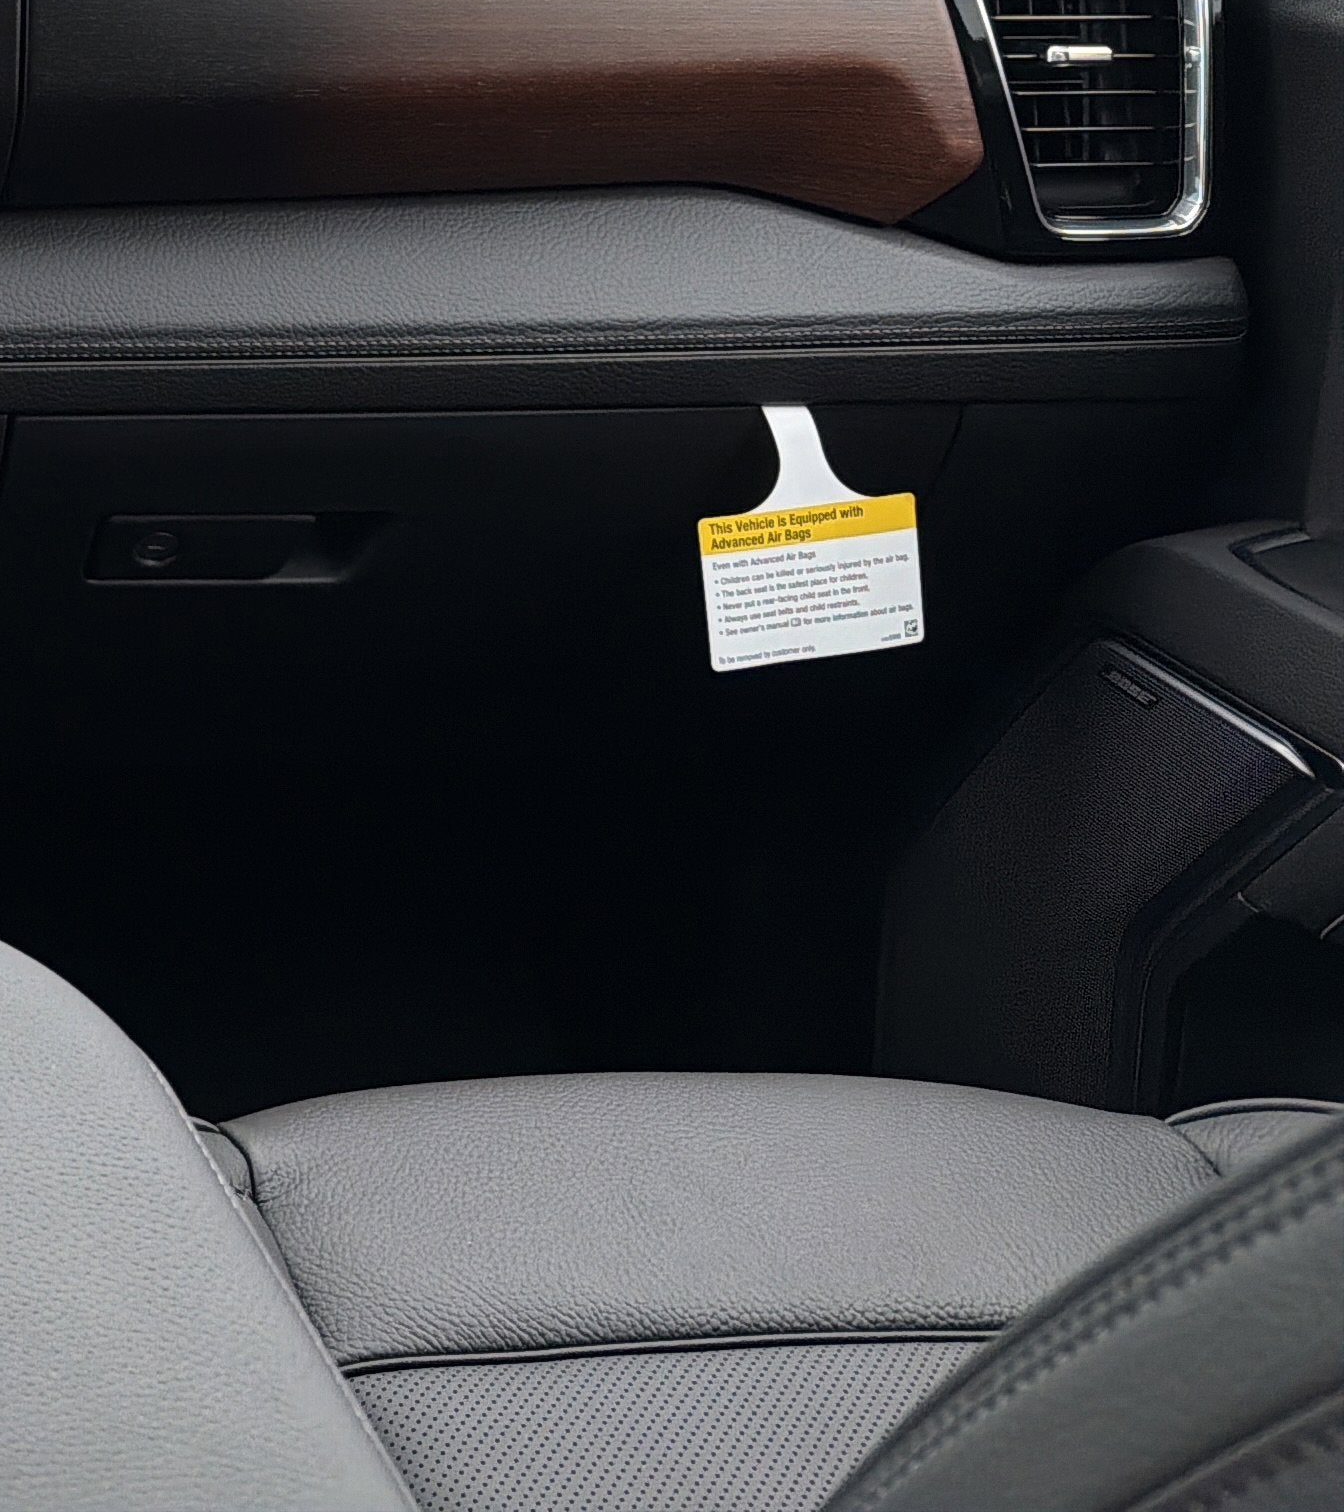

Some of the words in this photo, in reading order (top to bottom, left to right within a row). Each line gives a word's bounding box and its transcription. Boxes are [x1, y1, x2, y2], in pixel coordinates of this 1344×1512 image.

[708, 521, 733, 535] This
[735, 518, 775, 532] Vehicle
[789, 508, 837, 526] Equipped
[839, 506, 864, 518] with
[711, 533, 764, 550] Advanced
[767, 531, 782, 544] Air
[785, 528, 812, 541] Bags
[712, 561, 731, 571] Even
[733, 560, 749, 568] with
[750, 555, 785, 566] Advanced
[786, 552, 796, 561] Air
[798, 551, 817, 560] Bags
[720, 575, 750, 585] Children
[766, 571, 775, 579] be
[776, 569, 795, 578] killed
[806, 564, 836, 574] seriously
[837, 560, 862, 570] injured
[863, 559, 872, 568] by
[873, 557, 884, 565] the
[885, 555, 894, 563] air
[721, 589, 735, 598] The
[736, 587, 752, 596] back
[754, 585, 768, 594] seat
[776, 582, 787, 590] the
[788, 580, 809, 589] safest
[810, 578, 828, 588] place
[829, 575, 838, 583] for
[723, 602, 742, 610] Never
[744, 600, 756, 609] put
[800, 591, 816, 601] child
[817, 590, 832, 598] seat
[724, 615, 748, 623] Always
[796, 605, 809, 613] and
[810, 603, 826, 612] child
[725, 628, 738, 637] See
[803, 617, 812, 625] for
[772, 647, 800, 657] customer
[1103, 670, 1158, 706] BOSE
